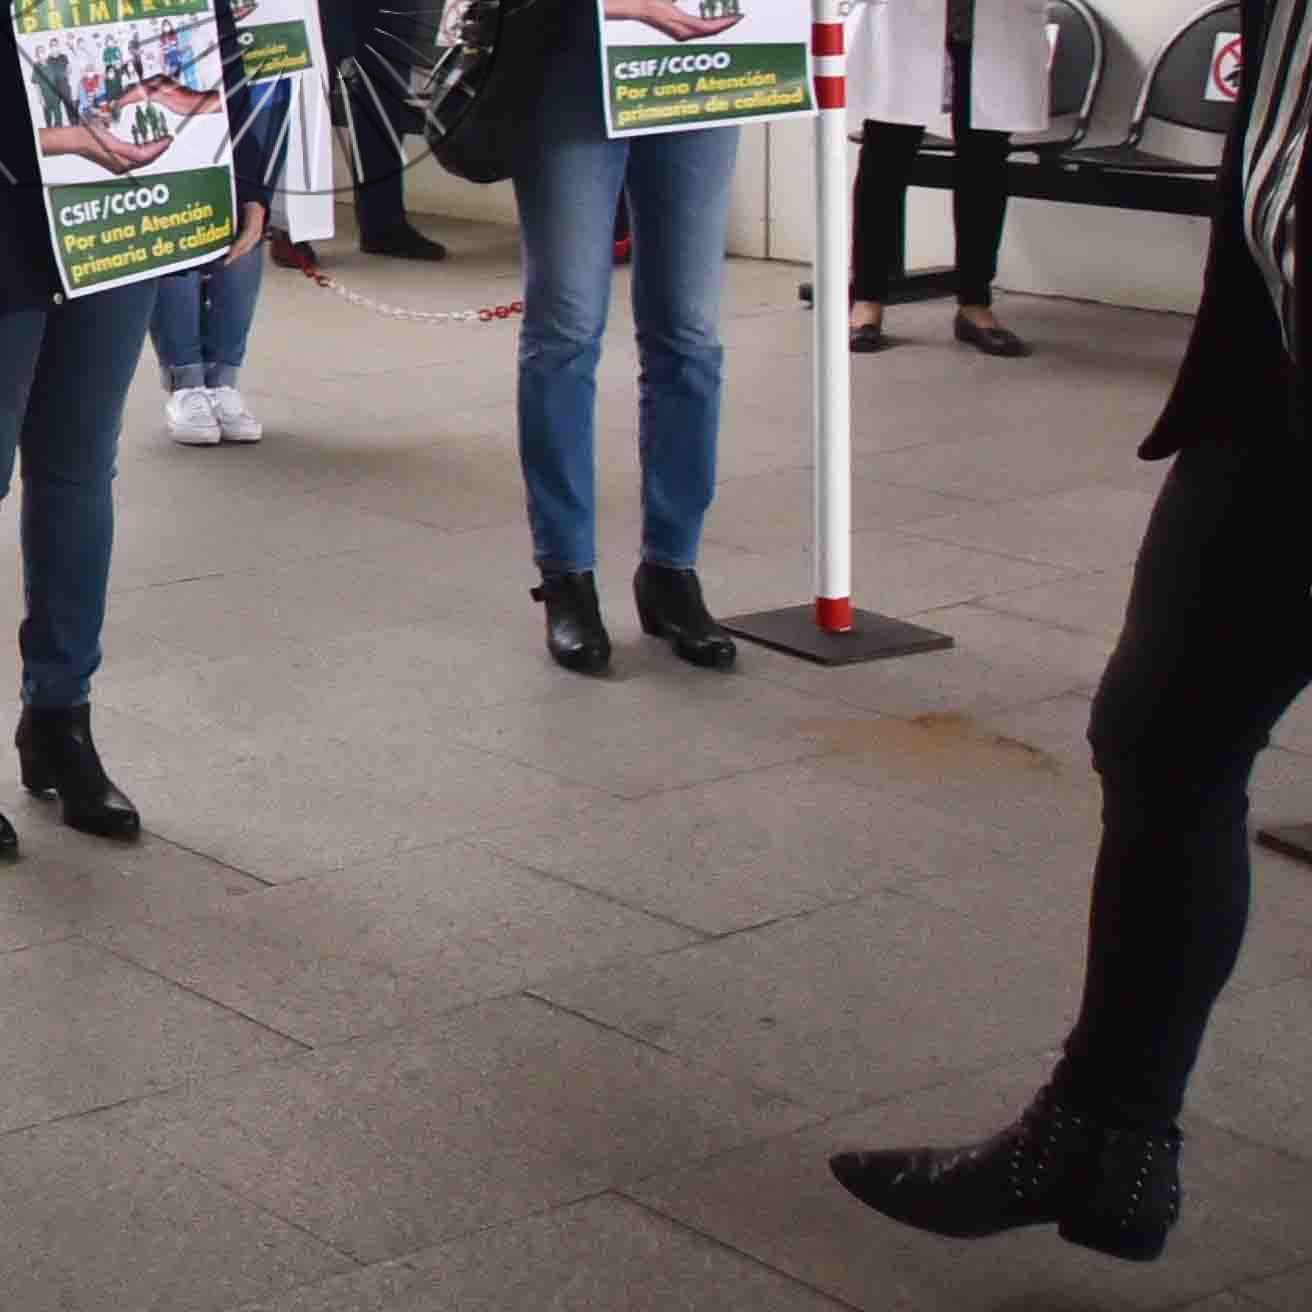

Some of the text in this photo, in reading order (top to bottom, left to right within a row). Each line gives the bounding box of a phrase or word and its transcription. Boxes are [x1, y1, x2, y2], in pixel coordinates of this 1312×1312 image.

[614, 52, 730, 79] CSIF/CCOO
[616, 71, 776, 101] Por una Atención
[704, 95, 729, 113] de
[60, 183, 169, 226] CSIF/CCOO
[64, 202, 214, 254] Por una Atención
[71, 218, 231, 283] primaria de calidad
